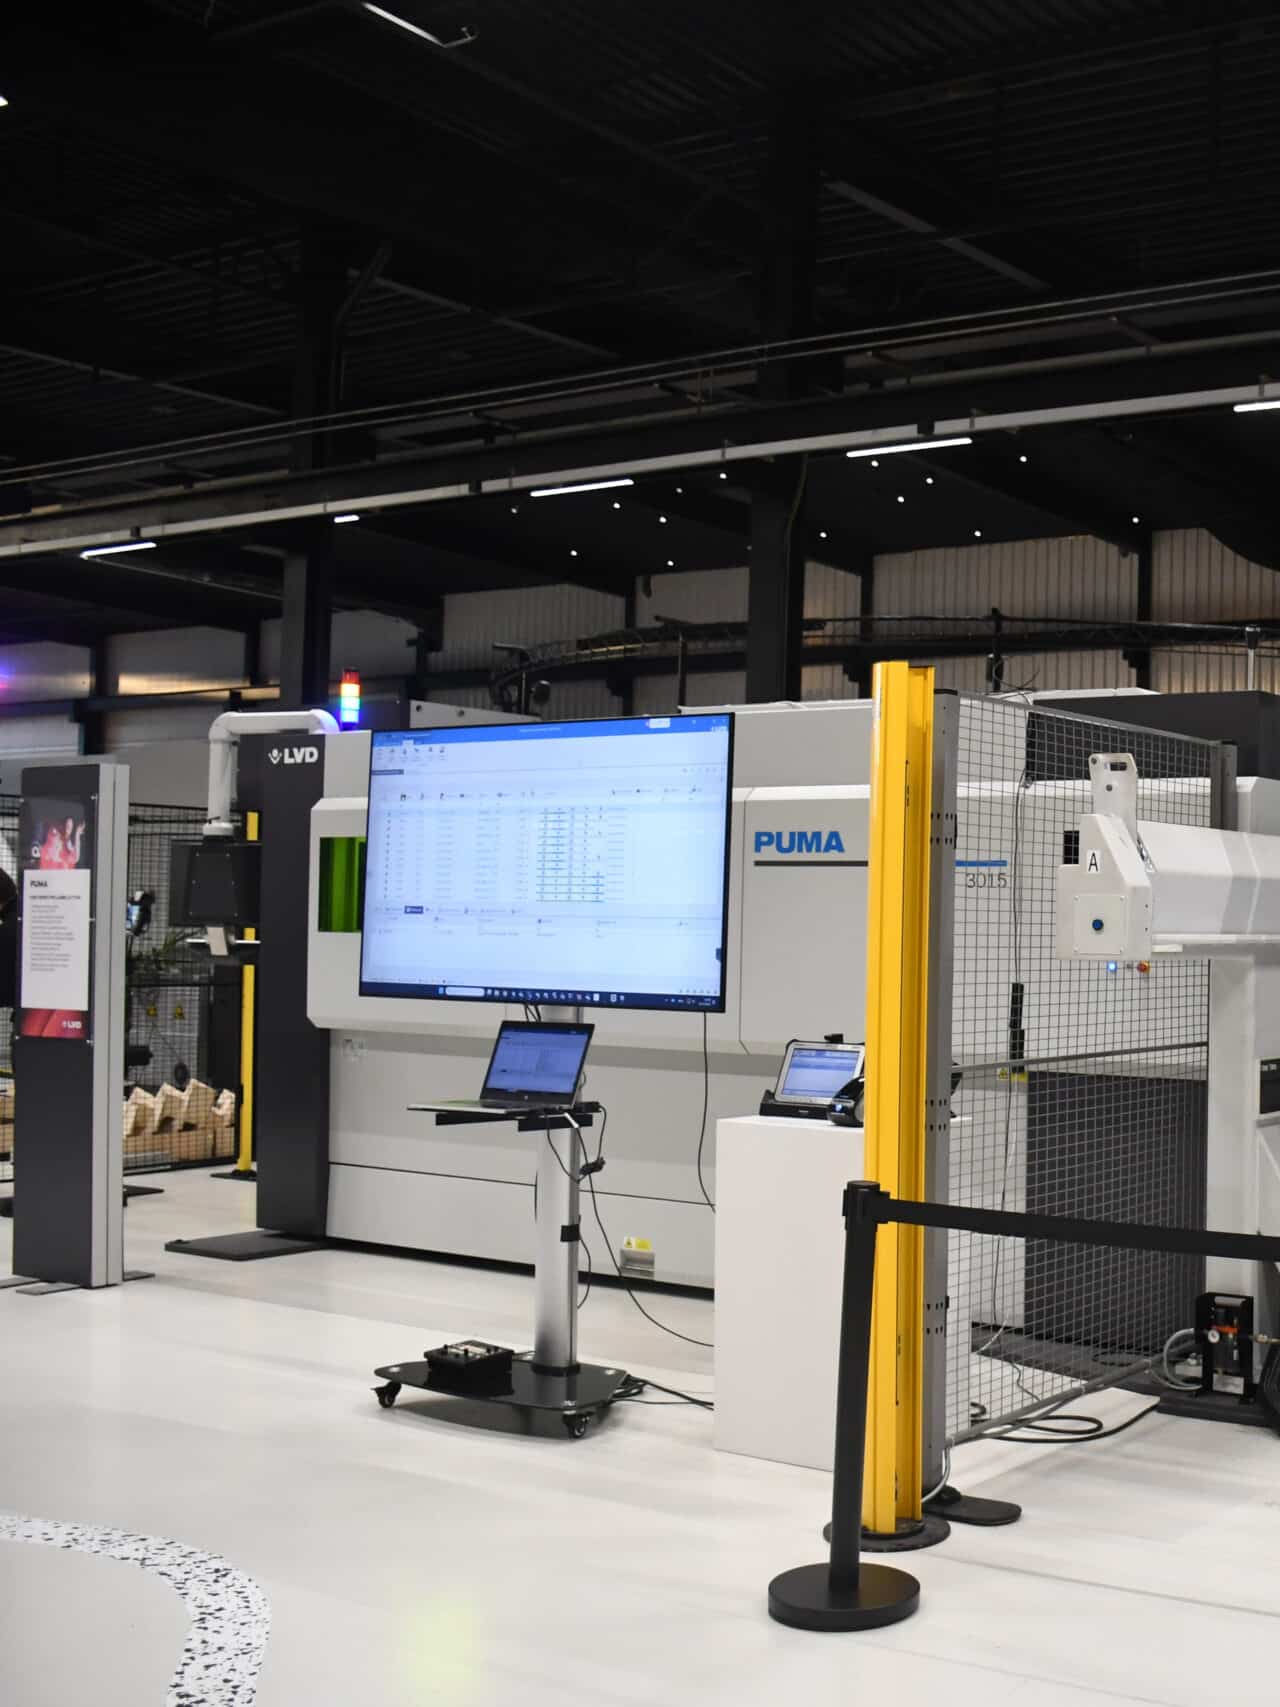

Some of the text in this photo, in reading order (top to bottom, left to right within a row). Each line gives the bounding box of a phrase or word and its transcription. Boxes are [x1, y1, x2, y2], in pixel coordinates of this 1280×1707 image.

[283, 746, 319, 764] LVD
[754, 831, 845, 854] PUMA
[1088, 852, 1099, 872] A
[966, 872, 1007, 889] 3015
